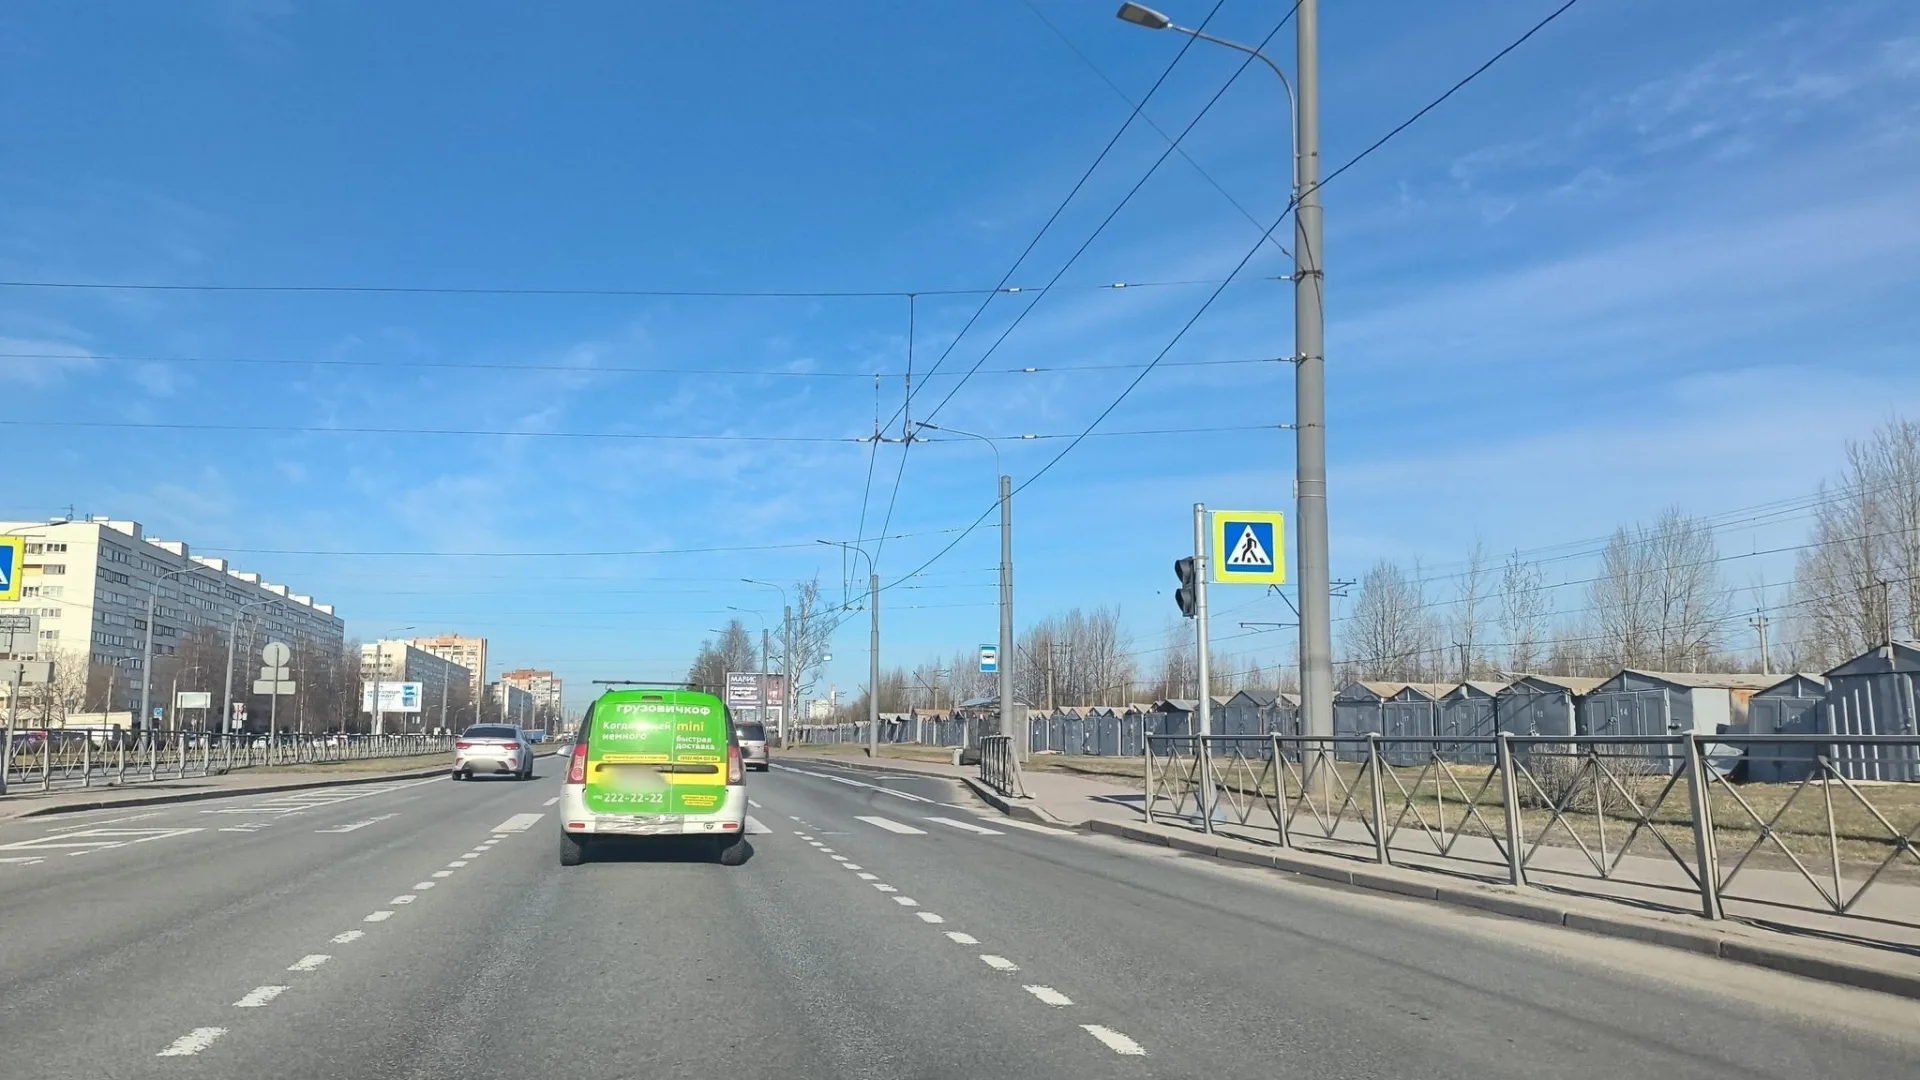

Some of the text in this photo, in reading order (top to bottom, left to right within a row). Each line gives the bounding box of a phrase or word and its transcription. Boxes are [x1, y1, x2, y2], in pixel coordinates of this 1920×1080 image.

[616, 704, 711, 716] грузовичкоф
[1619, 708, 1628, 716] 14
[676, 721, 704, 731] mini
[602, 733, 647, 741] немного
[676, 735, 712, 743] быстрая
[603, 793, 663, 803] 222-22-22
